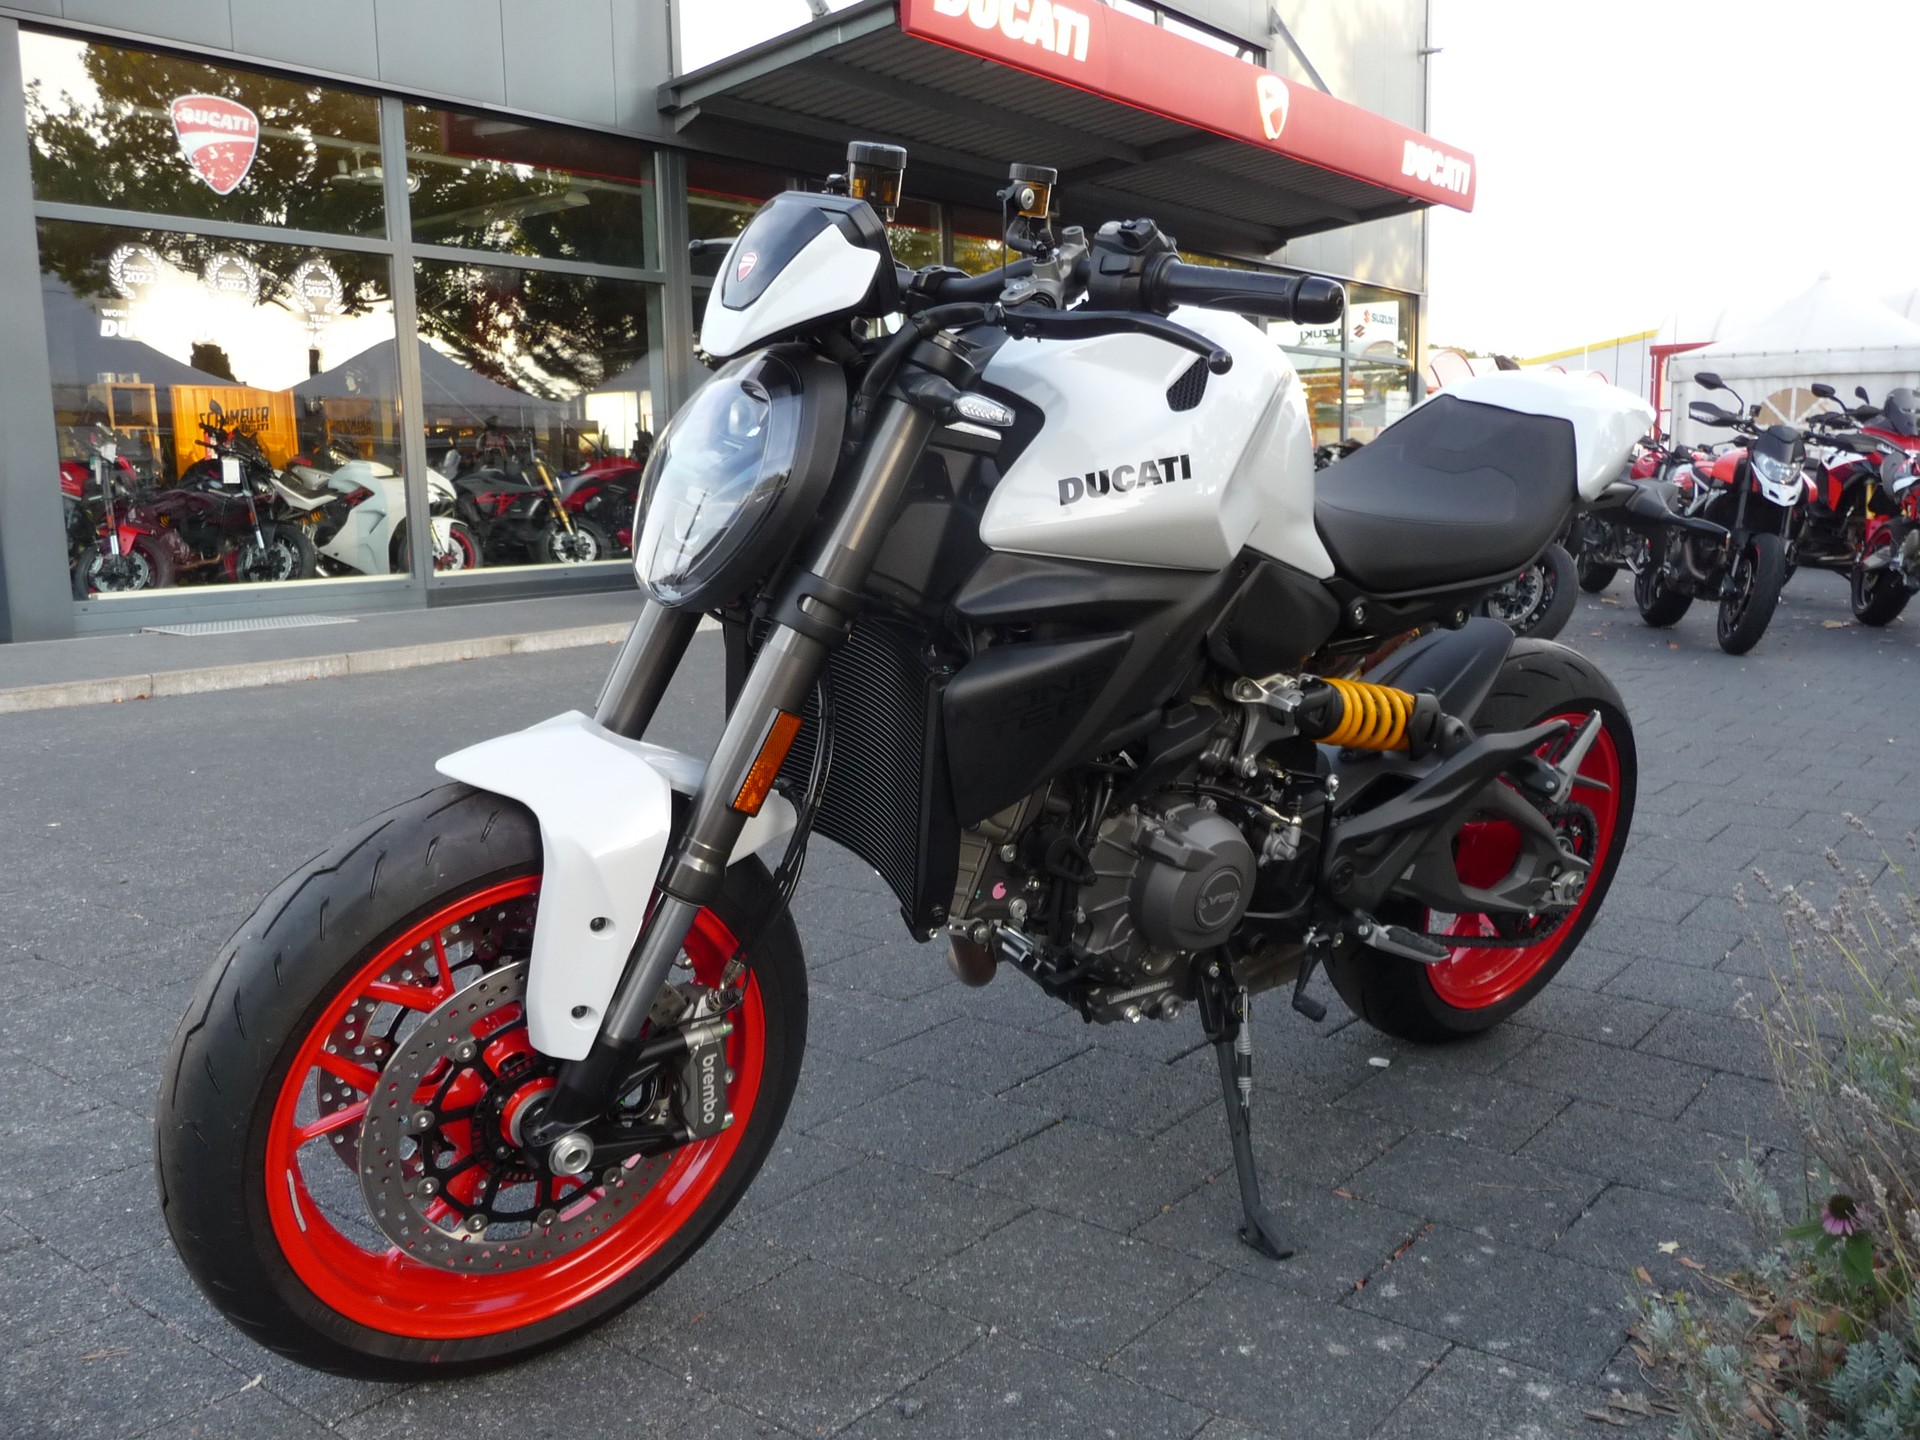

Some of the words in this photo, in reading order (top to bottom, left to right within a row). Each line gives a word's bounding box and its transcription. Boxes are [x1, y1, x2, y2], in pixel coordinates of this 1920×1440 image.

[933, 0, 1090, 62] UCATI
[181, 107, 249, 131] DUCATI
[1401, 140, 1471, 195] DUCATI
[123, 271, 156, 284] 2022
[218, 279, 248, 291] 2022
[304, 278, 331, 286] MotoGP
[304, 286, 332, 298] 2022
[1058, 453, 1192, 506] DUCATI
[702, 1052, 718, 1124] brembo
